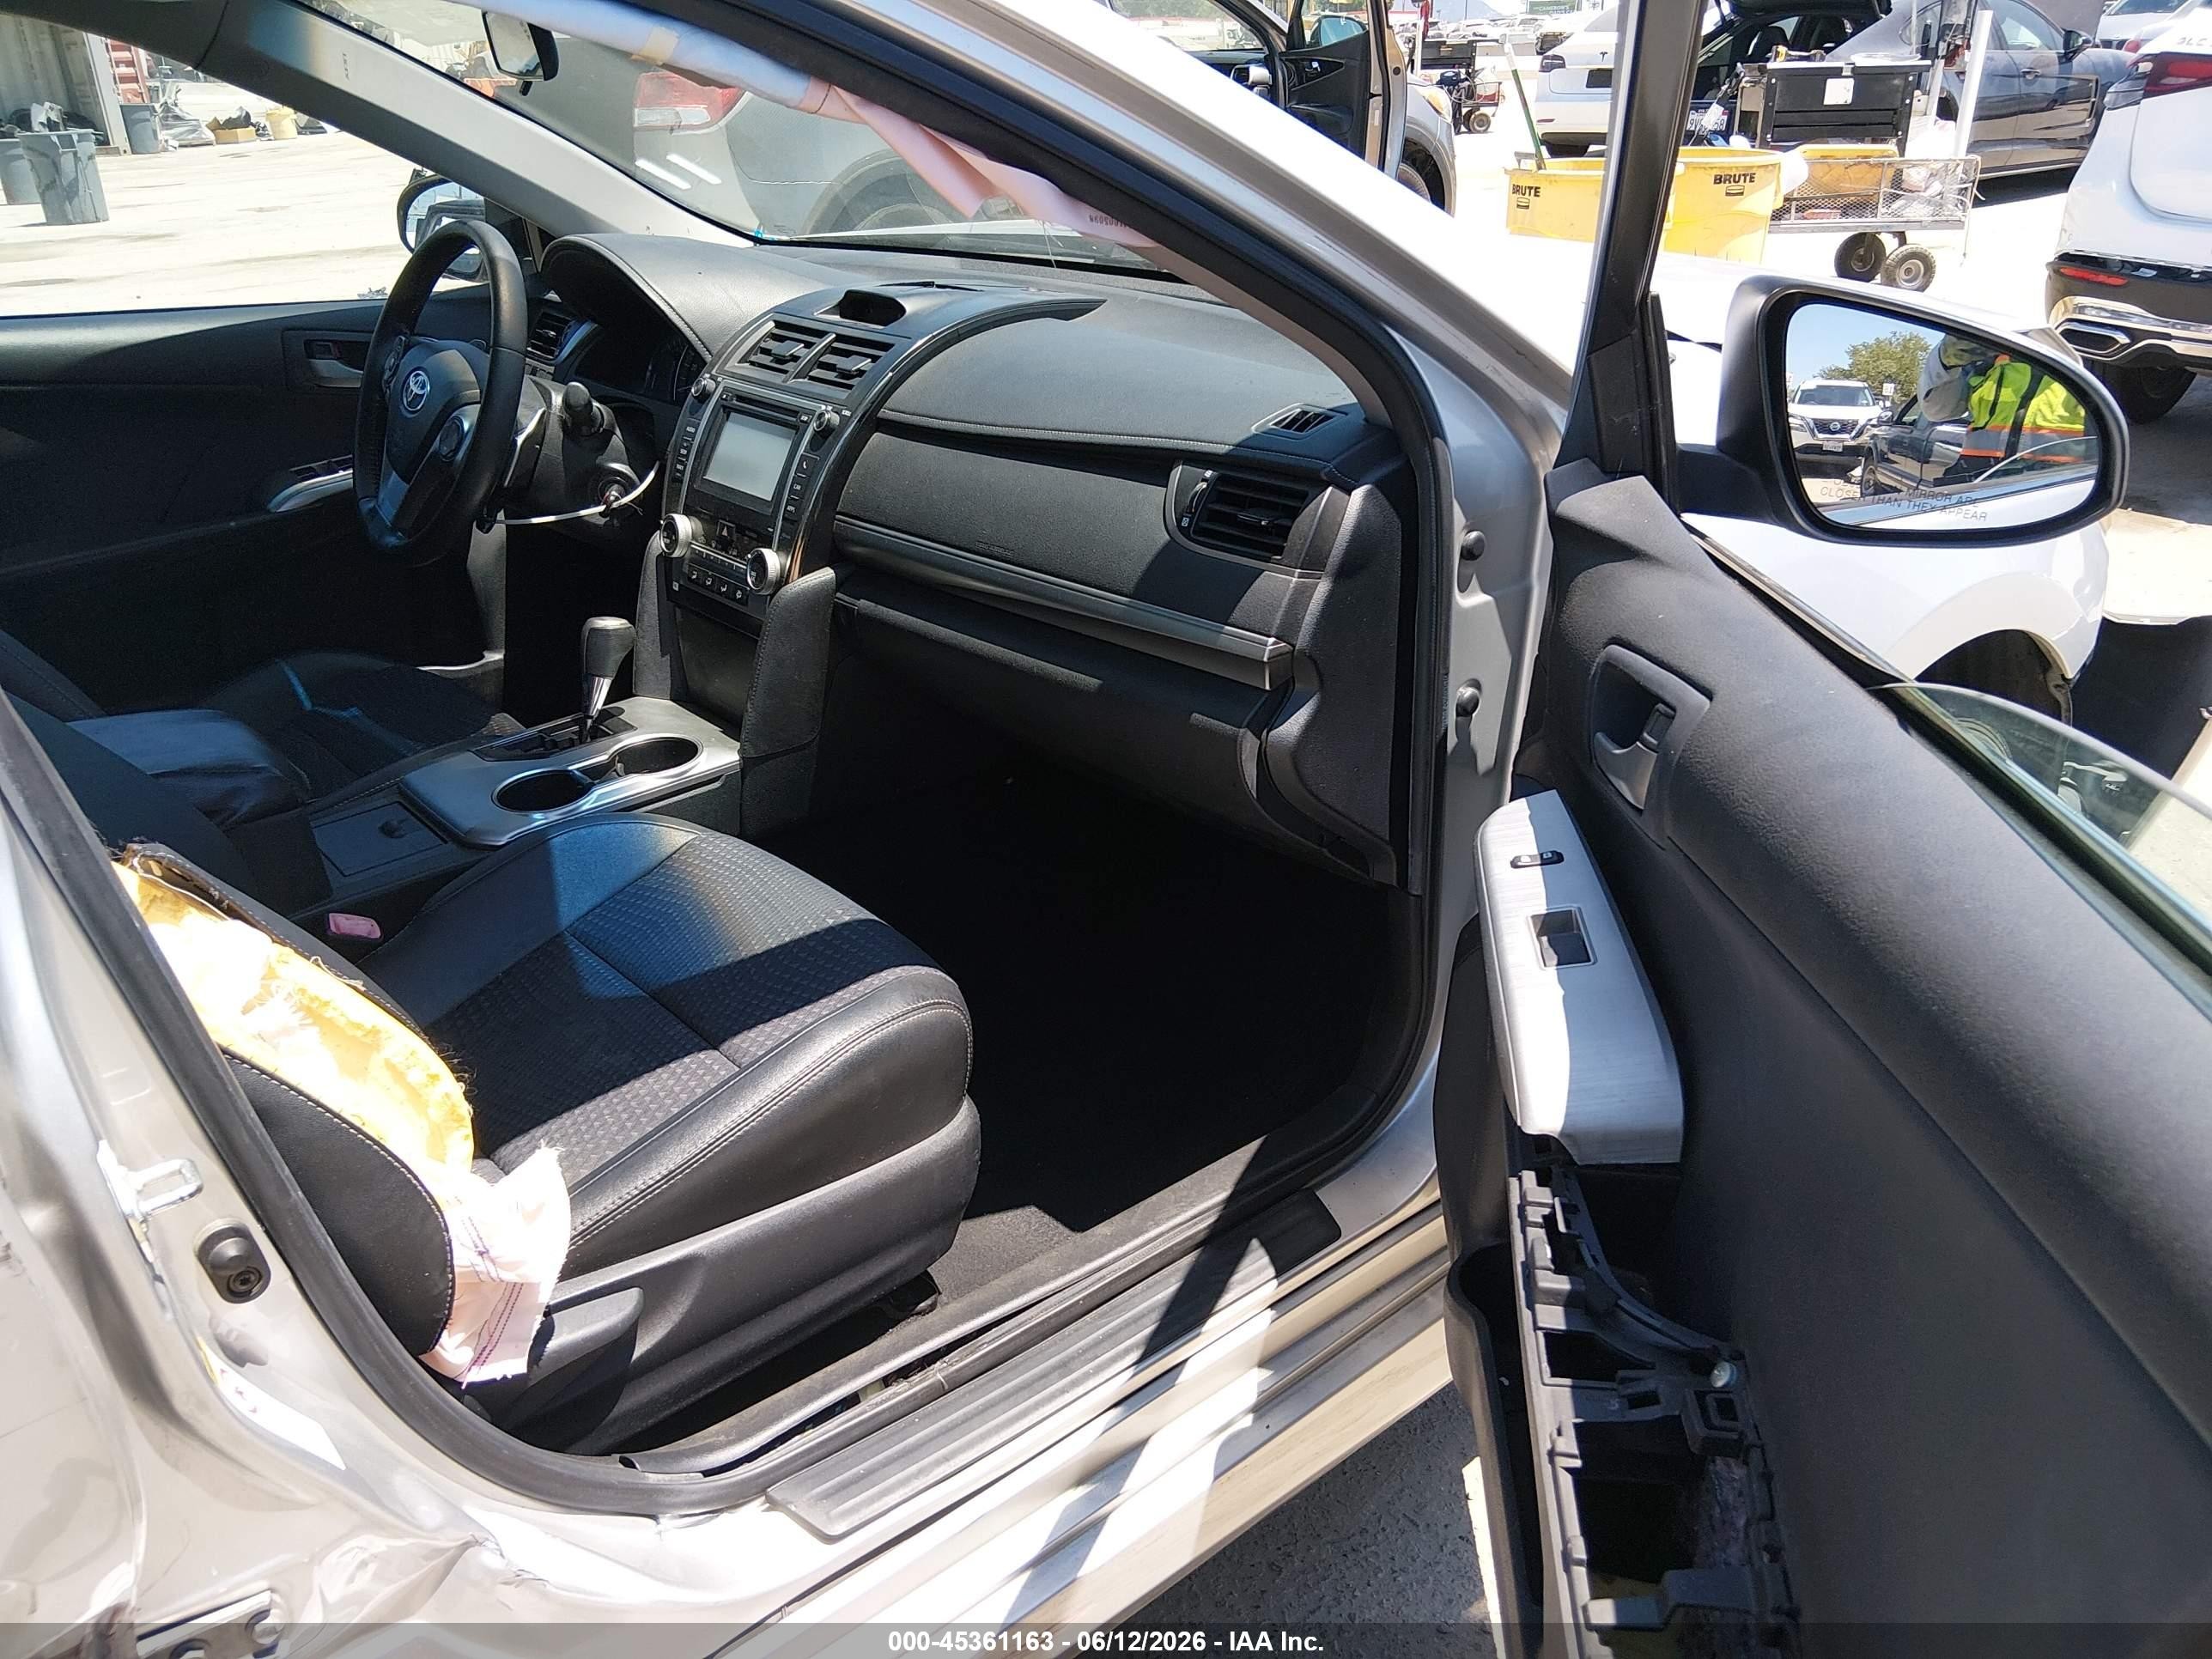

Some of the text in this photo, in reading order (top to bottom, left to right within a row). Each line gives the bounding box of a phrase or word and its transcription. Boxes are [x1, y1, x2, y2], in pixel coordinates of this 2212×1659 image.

[1713, 172, 1756, 185] BRUTE
[1512, 183, 1540, 198] BRUTE
[1903, 486, 1979, 508] MIRROR AR
[1871, 495, 1902, 508] THAN
[1906, 500, 1937, 513] THEY
[1939, 507, 1988, 522] APPEAR
